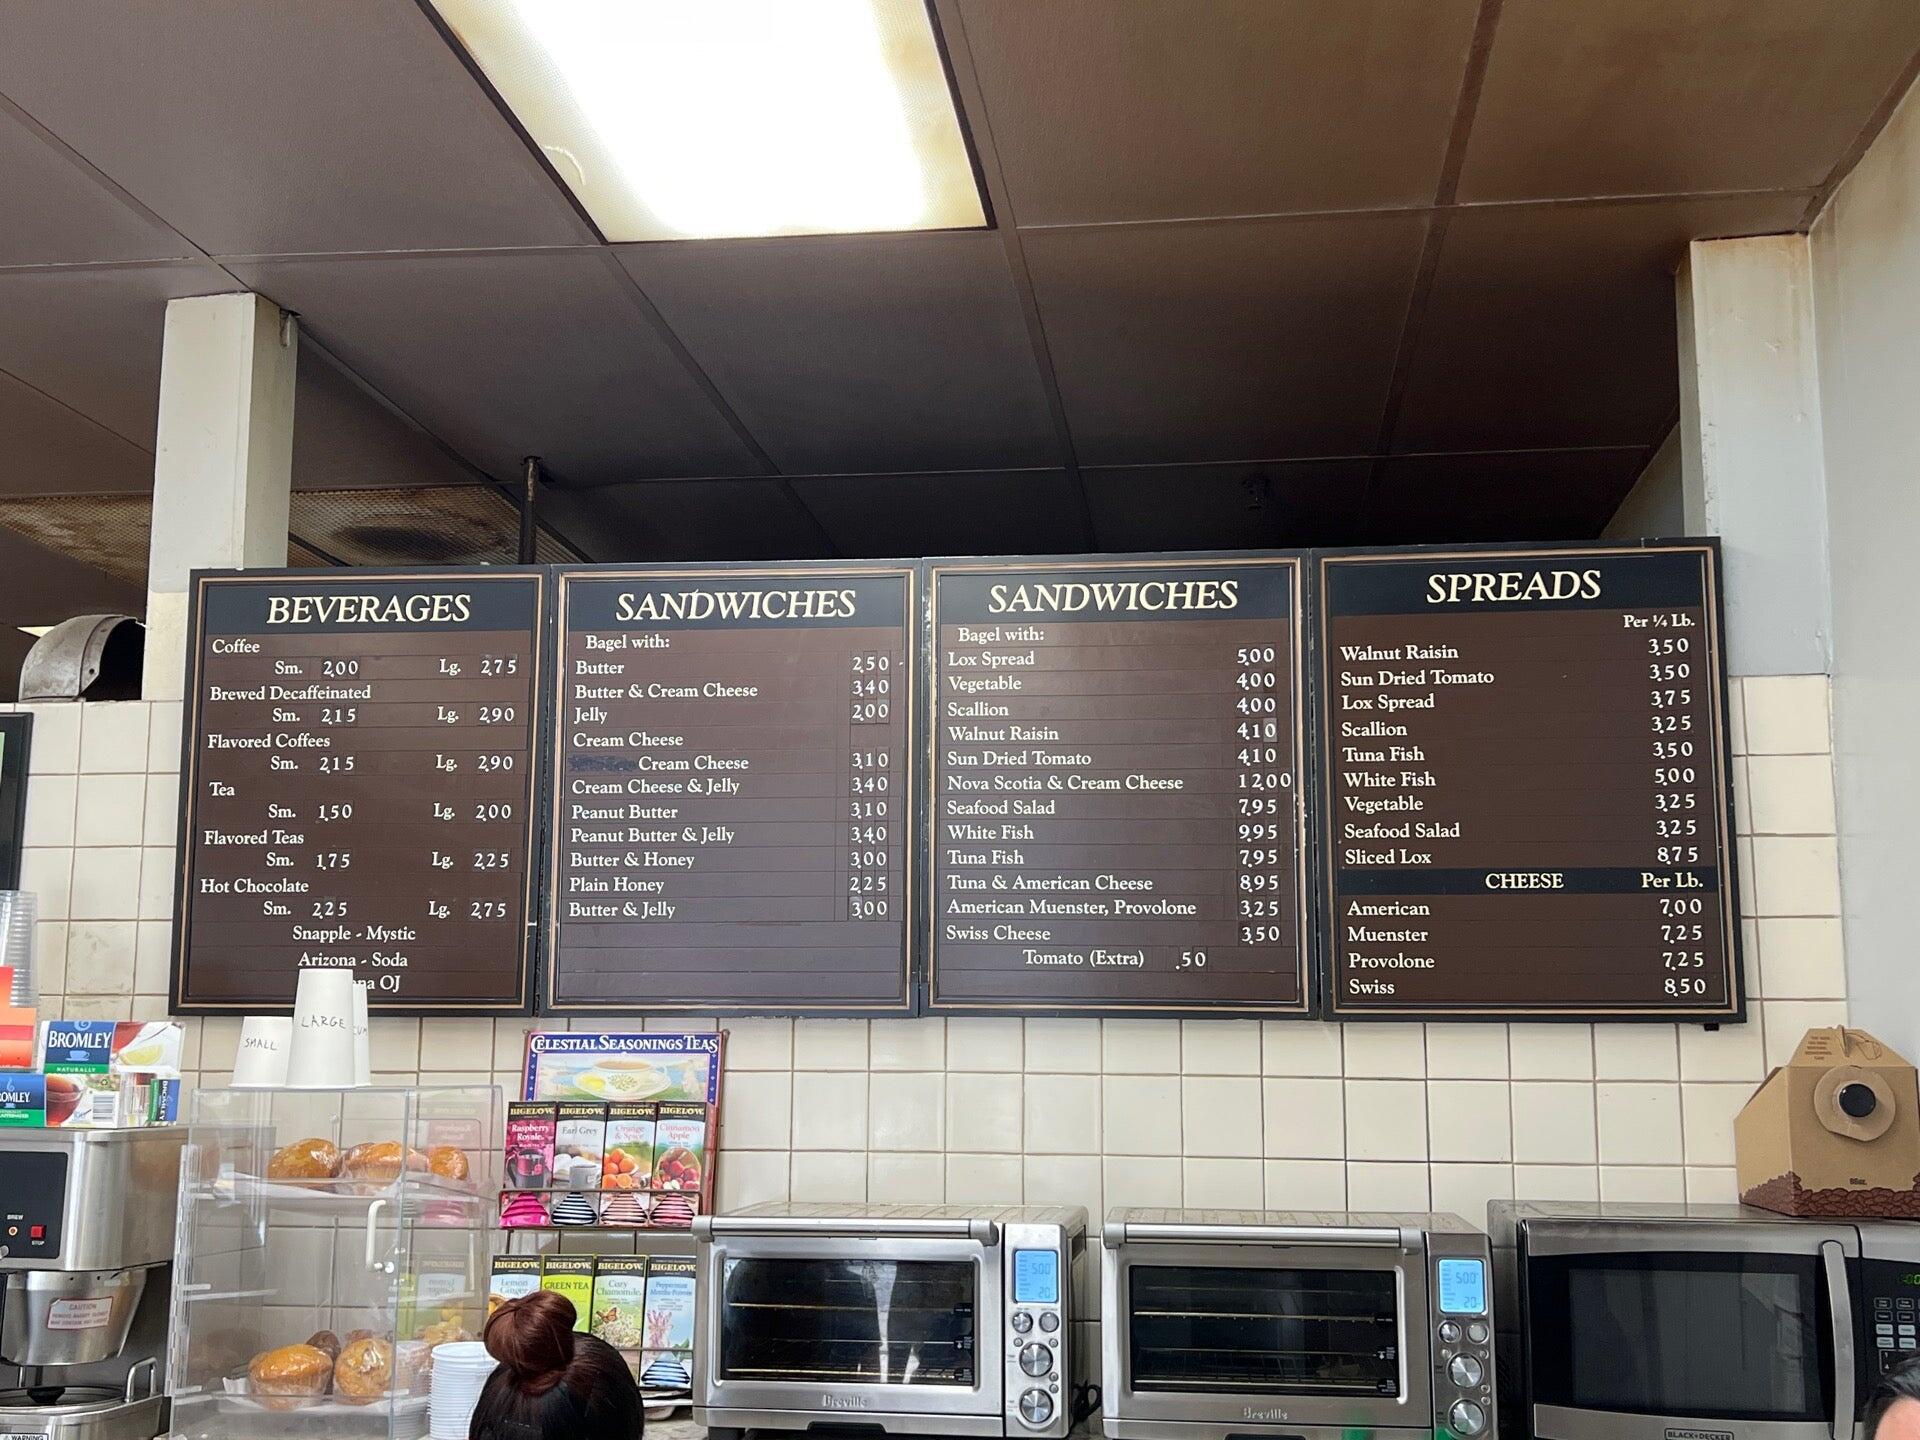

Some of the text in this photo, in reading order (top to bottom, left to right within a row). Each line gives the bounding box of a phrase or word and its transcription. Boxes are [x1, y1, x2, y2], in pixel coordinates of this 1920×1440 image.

[1426, 569, 1602, 604] SPREADS
[615, 588, 856, 622] SANDWICHES
[988, 580, 1239, 614] SANDWICHES
[266, 594, 471, 624] BEVERAGES
[1622, 612, 1696, 628] Per Lb.
[585, 633, 670, 653] Bagel with:
[957, 625, 1045, 645] Bagel with:
[211, 638, 261, 654] Coffee
[1339, 644, 1460, 662] Walnut Raisin
[575, 660, 625, 675] Butter
[947, 650, 1035, 669] Lox Spread
[948, 674, 1022, 694] Vegetable
[1340, 669, 1495, 687] Sun Dried Tomato
[209, 684, 372, 701] Brewed Decaffeinated
[574, 682, 759, 699] Butter & Cream Cheese
[947, 701, 1010, 717] Scallion
[1341, 692, 1436, 713] Lox Spread
[573, 706, 608, 725] Jelly
[947, 725, 1060, 741] Walnut Raisin
[1341, 720, 1408, 737] Scallion
[207, 732, 331, 749] Flavored Coffees
[573, 731, 684, 748] Cream Cheese
[638, 754, 750, 771] Cream Cheese
[947, 750, 1092, 766] Sun Dried Tomato
[1341, 745, 1426, 763] Tuna Fish
[571, 777, 740, 796] Cream Cheese & Jelly
[947, 774, 1184, 791] Nova Scotia & Cream Cheese
[1342, 770, 1437, 788] White Fish
[208, 781, 236, 797] Tea
[571, 804, 679, 820] Peanut Butter
[946, 799, 1056, 815] Seafood Salad
[1343, 794, 1424, 815] Vegetable
[203, 829, 305, 845] Flavored Teas
[570, 825, 735, 845] Peanut Butter & Jelly
[947, 824, 1035, 840] White Fish
[1344, 821, 1461, 840] Seafood Salad
[570, 851, 695, 870] Butter & Honey
[946, 849, 1025, 865] Tuna Fish
[1344, 848, 1432, 866] Sliced Lox
[200, 877, 310, 894] Hot Chocolate
[569, 876, 665, 895] Plain Honey
[946, 874, 1154, 891] Tuna & American Cheese
[1485, 872, 1565, 890] CHEESE
[1640, 871, 1704, 888] Per Lb.
[568, 900, 676, 920] Butter & Jelly
[946, 898, 1197, 917] American Muenster, Provolone
[1346, 900, 1431, 916] American
[292, 924, 416, 944] Snapple Mystic
[946, 924, 1051, 941] Swiss Cheese
[1347, 926, 1429, 942] Muenster
[297, 951, 409, 967] Arizona Soda
[1022, 949, 1145, 969] Tomato (Extra)
[1347, 952, 1435, 969] Provolone
[379, 974, 401, 994] OJ
[1349, 978, 1395, 995] Swiss
[300, 1014, 346, 1030] LARGE
[48, 1030, 112, 1048] BROMLEY
[244, 1037, 278, 1051] SMALL
[530, 1035, 719, 1054] CELESTIAL SEASONINGS TEAS
[510, 1107, 554, 1116] BIGELOW
[559, 1107, 604, 1116] BIGELOW
[610, 1107, 654, 1116] BIGELOW
[660, 1106, 704, 1115] BIGELOW
[511, 1124, 549, 1135] Raspberry
[494, 1261, 539, 1270] BIGELOW
[546, 1261, 591, 1270] BIGELOW
[597, 1262, 643, 1270] BIGELOW
[650, 1263, 695, 1272] BIGELOW
[544, 1281, 589, 1290] GREEN TEA
[822, 1394, 868, 1409] Breville
[1243, 1406, 1288, 1420] Breville
